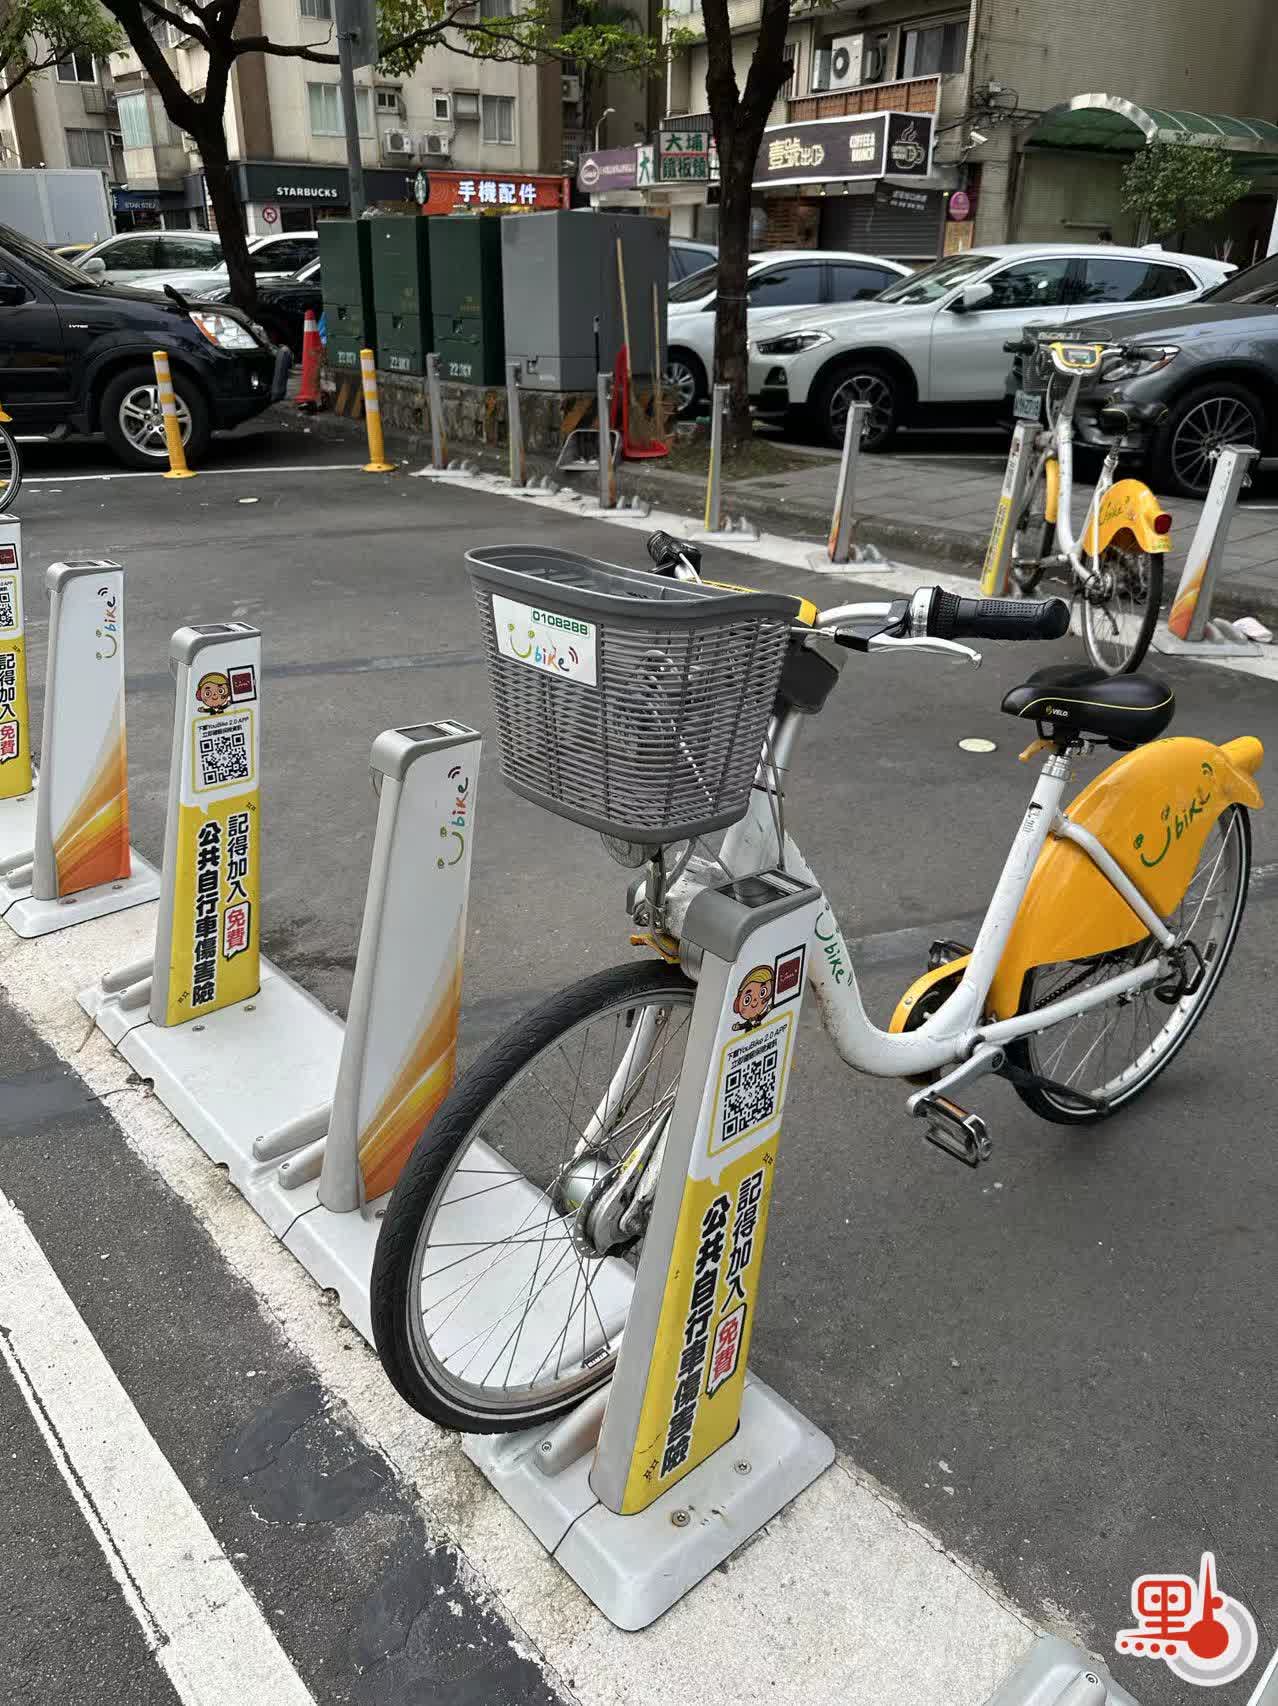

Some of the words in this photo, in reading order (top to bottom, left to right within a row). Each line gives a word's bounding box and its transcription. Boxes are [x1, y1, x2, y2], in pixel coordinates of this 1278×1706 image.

[276, 187, 338, 198] STARBUCKS
[458, 180, 537, 204] 手機配件
[532, 610, 588, 636] 0108288
[227, 813, 249, 903] 記得加入
[192, 821, 222, 1007] 公共自行車傷害險
[226, 908, 246, 949] 免費
[720, 1170, 763, 1313] 記得加入
[661, 1195, 730, 1479] 公共自行車傷害險
[714, 1316, 739, 1382] 免費
